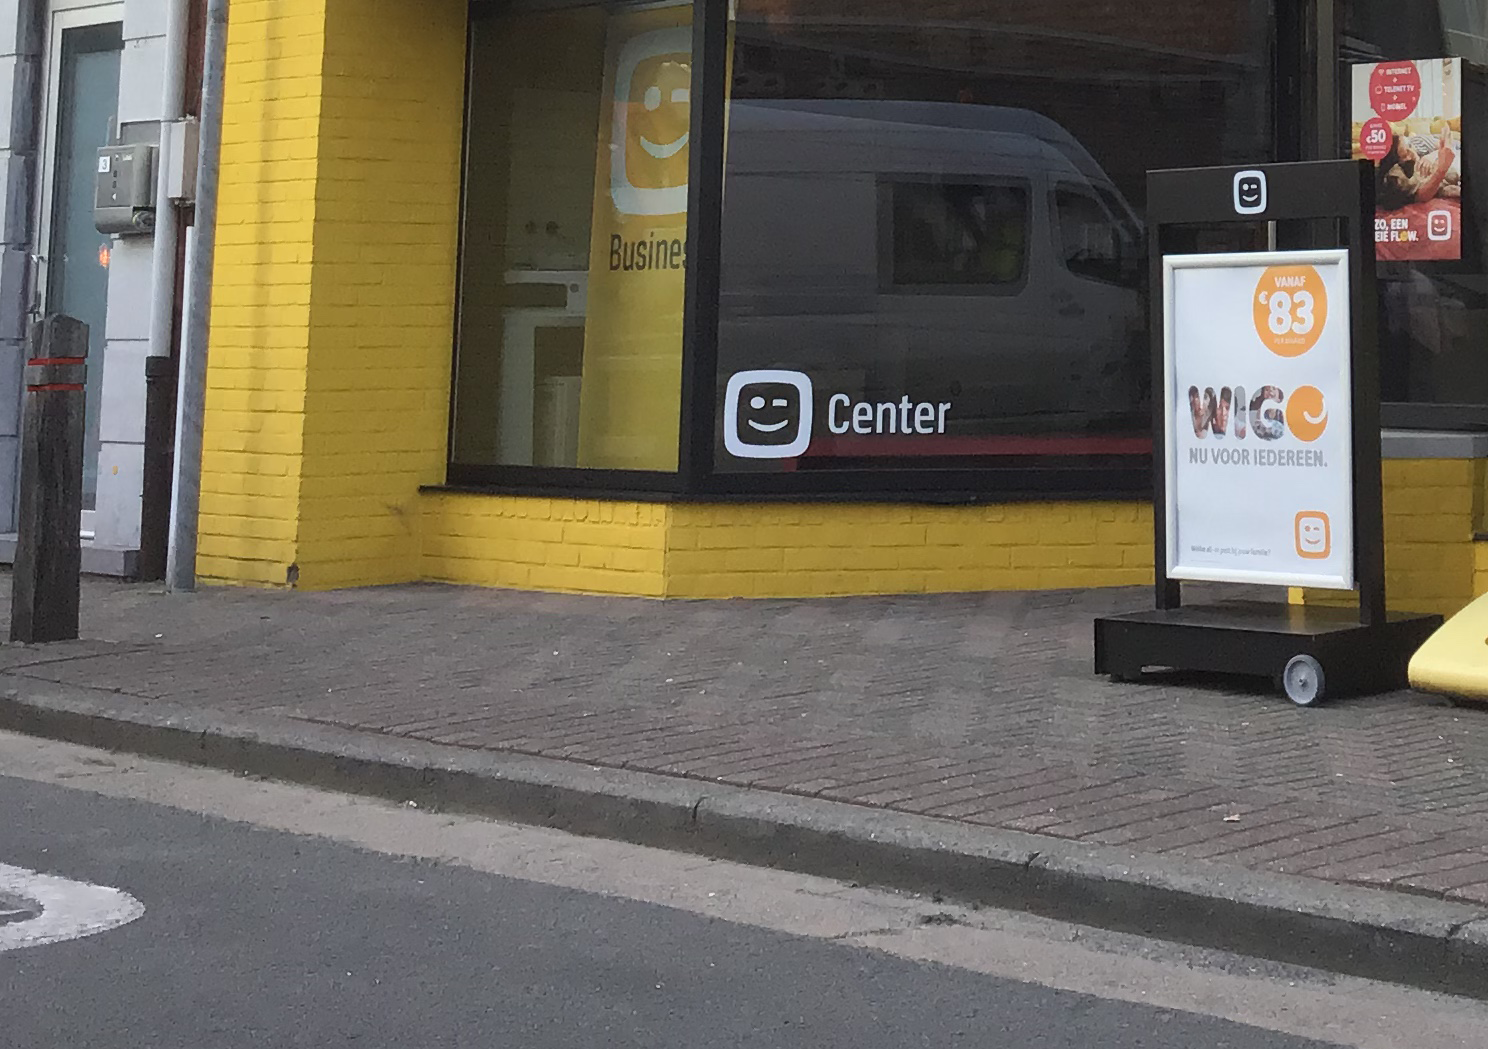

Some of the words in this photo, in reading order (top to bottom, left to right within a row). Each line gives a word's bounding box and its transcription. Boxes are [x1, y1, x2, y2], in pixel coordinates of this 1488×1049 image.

[102, 159, 107, 170] 3
[1391, 219, 1408, 230] EEN
[609, 231, 687, 271] Busine
[1274, 276, 1306, 288] VANAF
[828, 393, 951, 435] Center
[1189, 448, 1208, 464] NU
[1211, 448, 1250, 466] VOOR
[1253, 449, 1328, 467] IEDEREEN.
